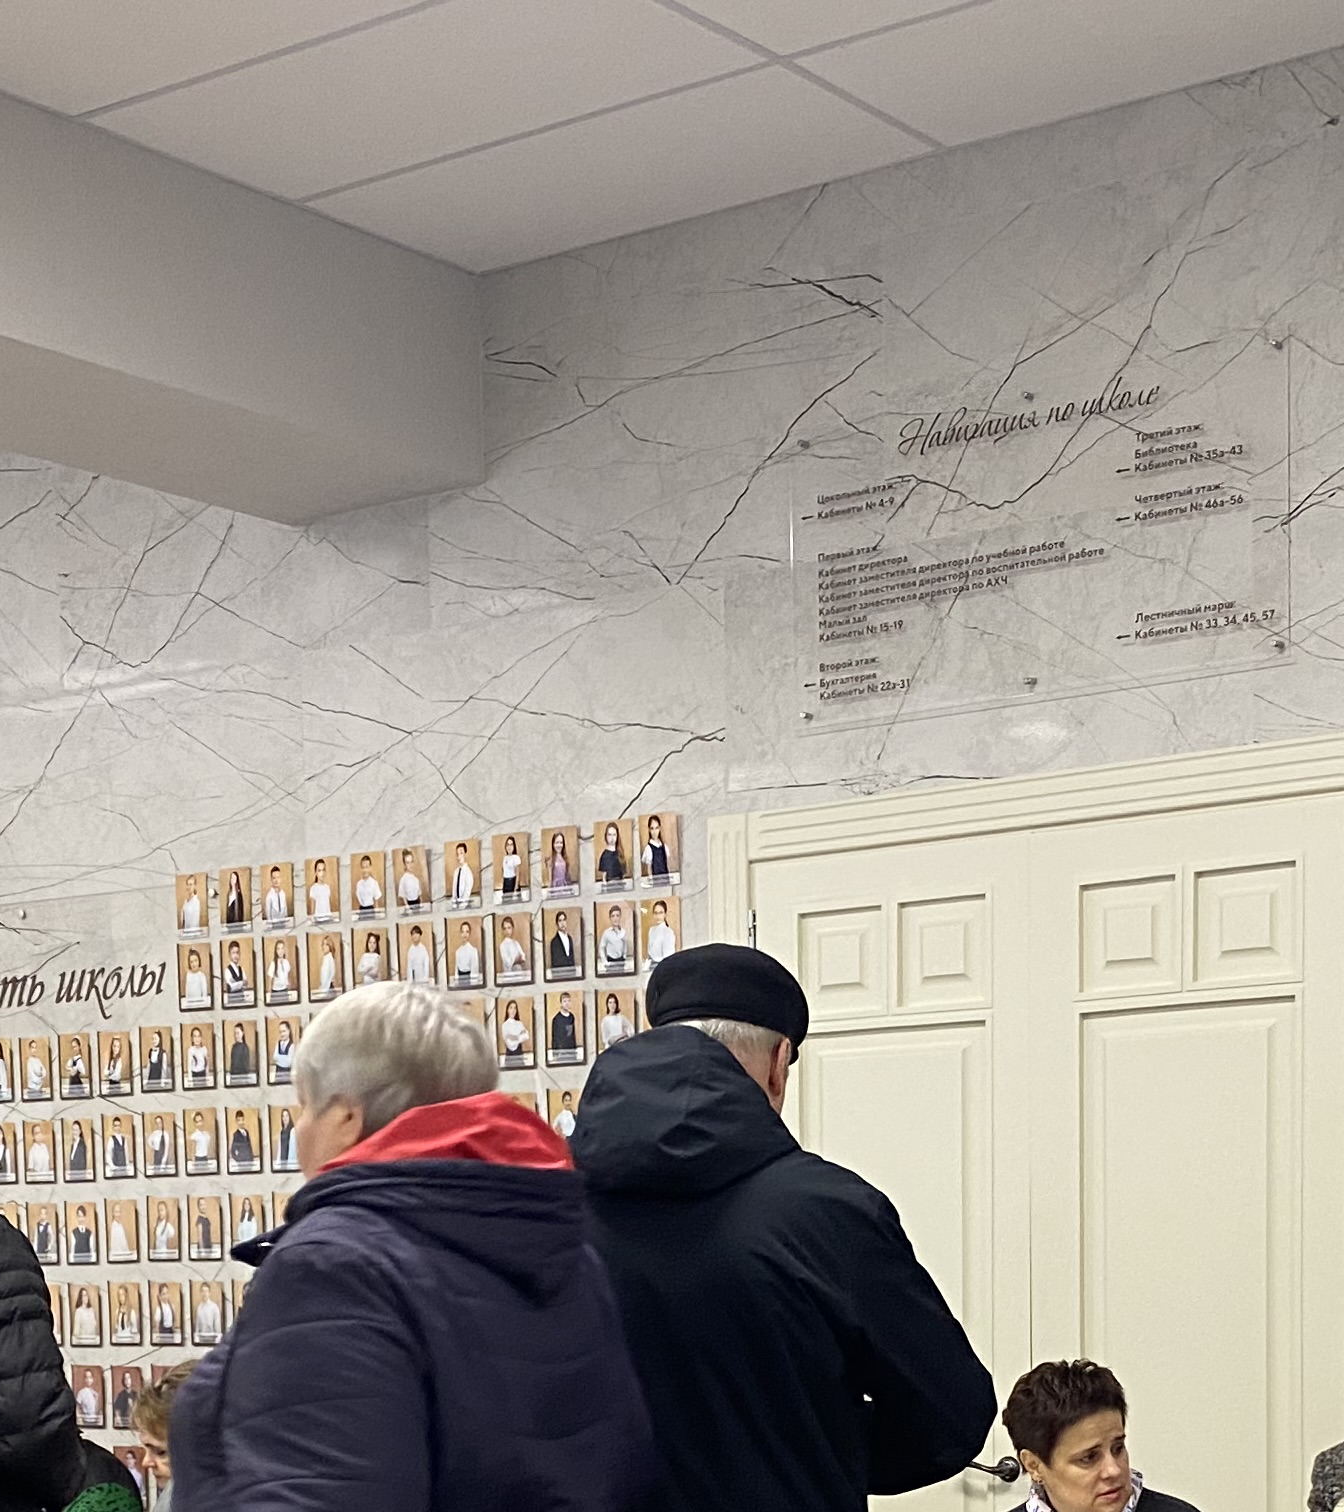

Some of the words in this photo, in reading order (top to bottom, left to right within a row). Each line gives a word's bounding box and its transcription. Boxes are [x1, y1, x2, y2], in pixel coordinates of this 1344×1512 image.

[898, 406, 1040, 455] Навигация
[1046, 402, 1074, 426] по
[1081, 377, 1160, 416] школе
[1136, 426, 1173, 443] Третий
[1135, 441, 1198, 460] Библиотека
[1135, 457, 1187, 473] Кабинеты
[817, 486, 870, 505] Цокольный
[1135, 485, 1193, 504] Четвертый
[817, 505, 863, 520] Кабинеты
[878, 496, 895, 508] 4-9
[1135, 506, 1187, 521] Кабинеты
[1204, 494, 1244, 509] 46а-56
[818, 547, 854, 563] Первый
[818, 578, 857, 591] Кабинет
[859, 567, 916, 584] заместителя
[918, 556, 970, 573] директора
[971, 554, 984, 565] по
[986, 545, 1027, 564] учебной
[1029, 539, 1065, 556] работе
[818, 565, 856, 579] Кабинет
[858, 555, 908, 572] директора
[818, 590, 857, 604] Кабинет
[859, 581, 917, 597] заместителя
[918, 570, 970, 588] директора
[971, 568, 984, 577] по
[986, 554, 1066, 575] воспитательной
[1067, 546, 1105, 563] работе
[818, 603, 857, 617] Кабинет
[859, 593, 917, 610] заместителя
[918, 585, 970, 602] директора
[971, 582, 984, 591] по
[986, 576, 1008, 588] АХЧ
[818, 615, 851, 629] Малый
[852, 615, 868, 624] зал
[1135, 603, 1202, 623] Лестничный
[819, 628, 864, 642] Кабинеты
[879, 620, 904, 632] 15-19
[1135, 624, 1188, 640] Кабинеты
[1190, 621, 1203, 631] №
[1261, 609, 1276, 621] 57
[819, 658, 853, 673] Второй
[819, 672, 877, 690] Бухгалтерия
[819, 686, 865, 701] Кабинеты
[54, 961, 167, 1020] школы
